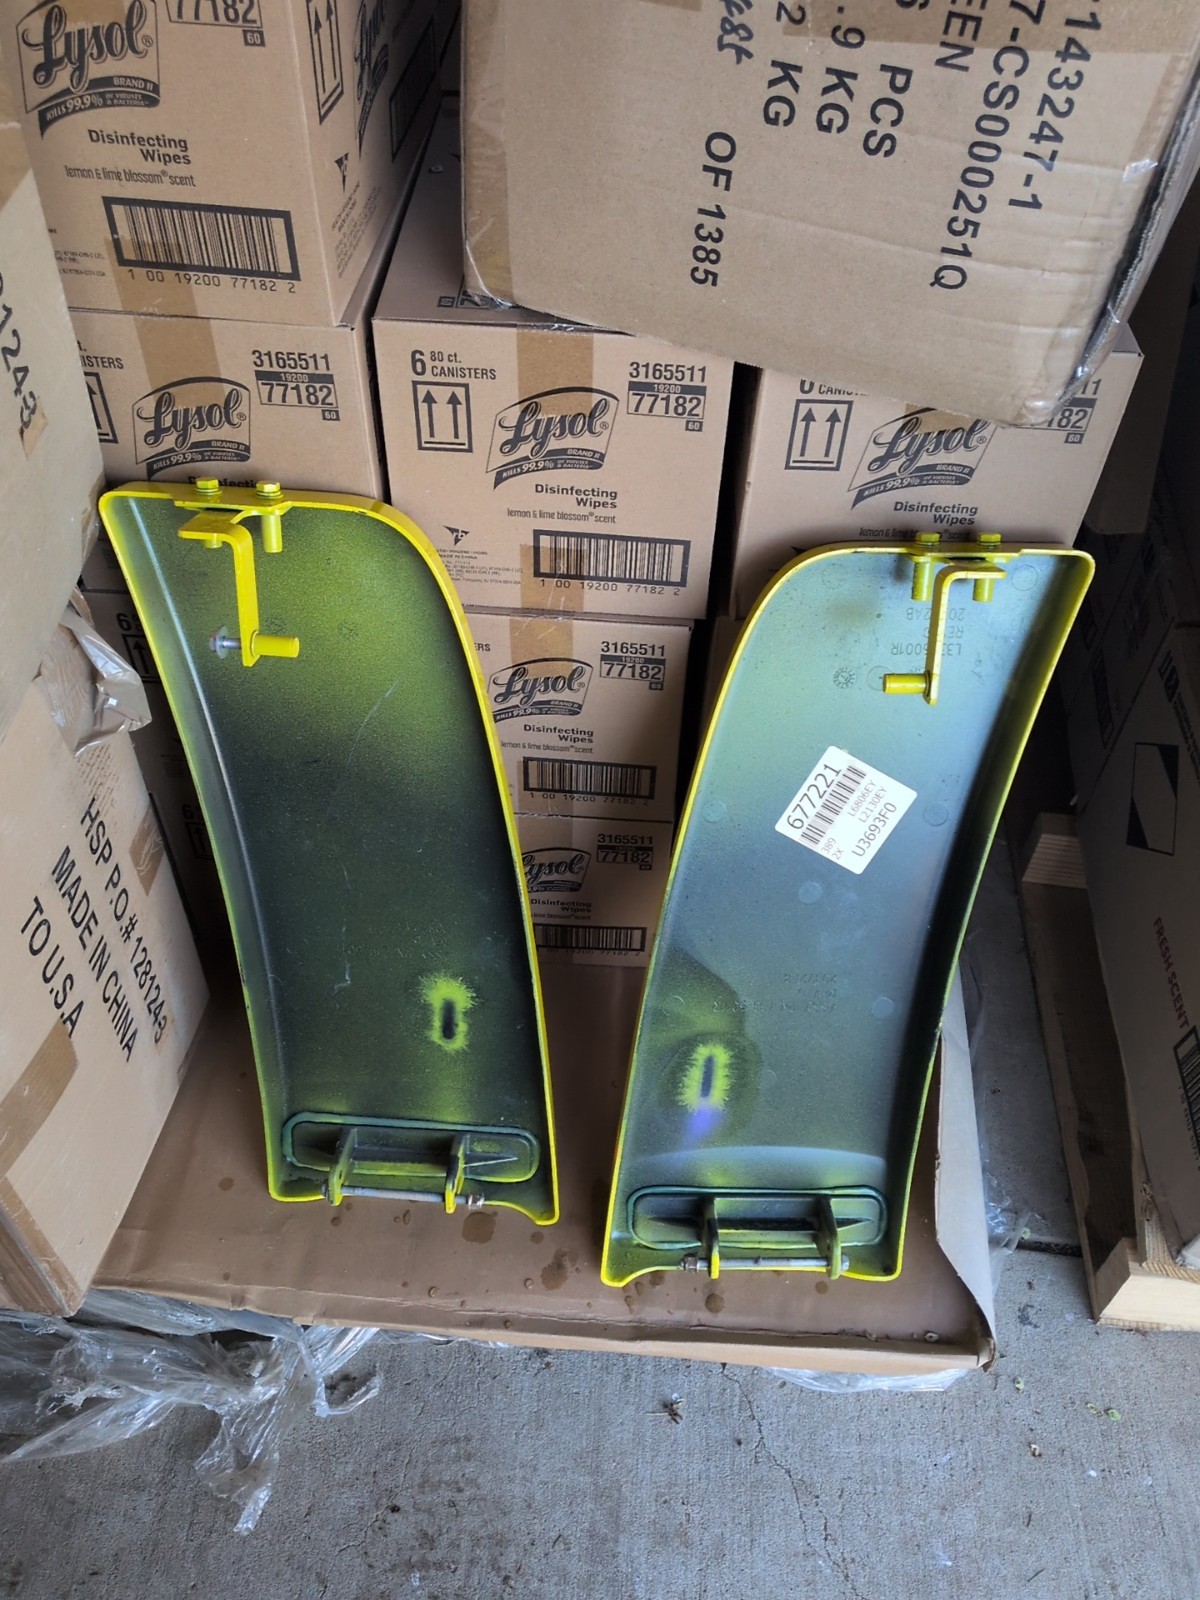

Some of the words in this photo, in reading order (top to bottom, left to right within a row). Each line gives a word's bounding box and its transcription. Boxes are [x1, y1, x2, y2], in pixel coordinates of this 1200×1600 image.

[776, 1, 806, 25] 2
[247, 33, 260, 44] 60
[113, 77, 144, 89] BRAND
[763, 60, 803, 126] KG
[816, 67, 858, 134] KG
[46, 104, 66, 120] KILLS
[66, 95, 103, 112] 99.9%
[863, 64, 913, 157] PCS
[88, 129, 188, 152] Disinfecting
[140, 148, 191, 166] Wipes
[702, 131, 737, 192] OF
[64, 165, 94, 179] lemon
[96, 168, 101, 179] &
[102, 166, 121, 181] lime
[168, 174, 196, 187] scent
[690, 203, 728, 287] 1385
[128, 269, 135, 280] 1
[146, 269, 164, 282] 00
[174, 273, 220, 287] 19200
[230, 277, 276, 291] 77182
[288, 282, 296, 293] 2
[252, 350, 330, 371] 3165511
[411, 349, 426, 376] 6
[430, 351, 444, 362] 80
[447, 352, 461, 363] ct.
[280, 373, 308, 382] 19200
[431, 365, 496, 380] CANISTERS
[629, 361, 706, 382] 3165511
[261, 382, 334, 405] 77182
[653, 384, 681, 393] 19200
[632, 392, 702, 417] 77182
[325, 411, 336, 419] 60
[688, 422, 699, 430] 60
[211, 440, 237, 449] BRAND
[567, 448, 593, 457] BRAND
[153, 460, 170, 470] KILLS
[170, 452, 201, 465] 99.9%
[502, 467, 521, 479] KILLS
[522, 460, 554, 472] 99.9%
[936, 464, 963, 473] BRAND
[535, 484, 618, 500] Disinfecting
[863, 485, 884, 496] KILLS
[885, 477, 920, 490] 99.9%
[576, 498, 617, 509] Wipes
[893, 501, 978, 516] Disinfecting
[507, 508, 531, 518] lemon
[533, 510, 537, 518] &
[538, 510, 555, 519] lime
[594, 514, 616, 524] scent
[933, 514, 976, 526] Wipes
[540, 579, 545, 587] 1
[556, 580, 570, 588] 00
[580, 581, 618, 591] 19200
[627, 585, 664, 595] 77182
[117, 613, 131, 631] 6
[601, 641, 665, 657] 3165511
[603, 662, 662, 680] 77182
[523, 724, 593, 737] Disinfecting
[558, 735, 593, 744] Wipes
[501, 741, 521, 749] lemon
[563, 794, 596, 802] 19200
[787, 763, 841, 830] 677221
[858, 785, 888, 823] L2130EY
[821, 837, 837, 855] 389
[847, 779, 877, 818] L6806EY
[852, 802, 898, 857] U3693F0
[597, 833, 653, 845] 3165511
[600, 851, 650, 863] 77182
[531, 899, 592, 908] Disinfecting
[80, 796, 113, 865] HSP
[104, 863, 138, 943] P.O.#
[130, 936, 167, 1044] 1281243
[51, 845, 99, 951] MADE
[88, 934, 111, 982] IN
[102, 970, 138, 1062] CHINA
[20, 896, 51, 956] TO
[42, 944, 84, 1039] U.S.A
[1153, 916, 1173, 972] FRESH
[1167, 971, 1190, 1028] SCENT
